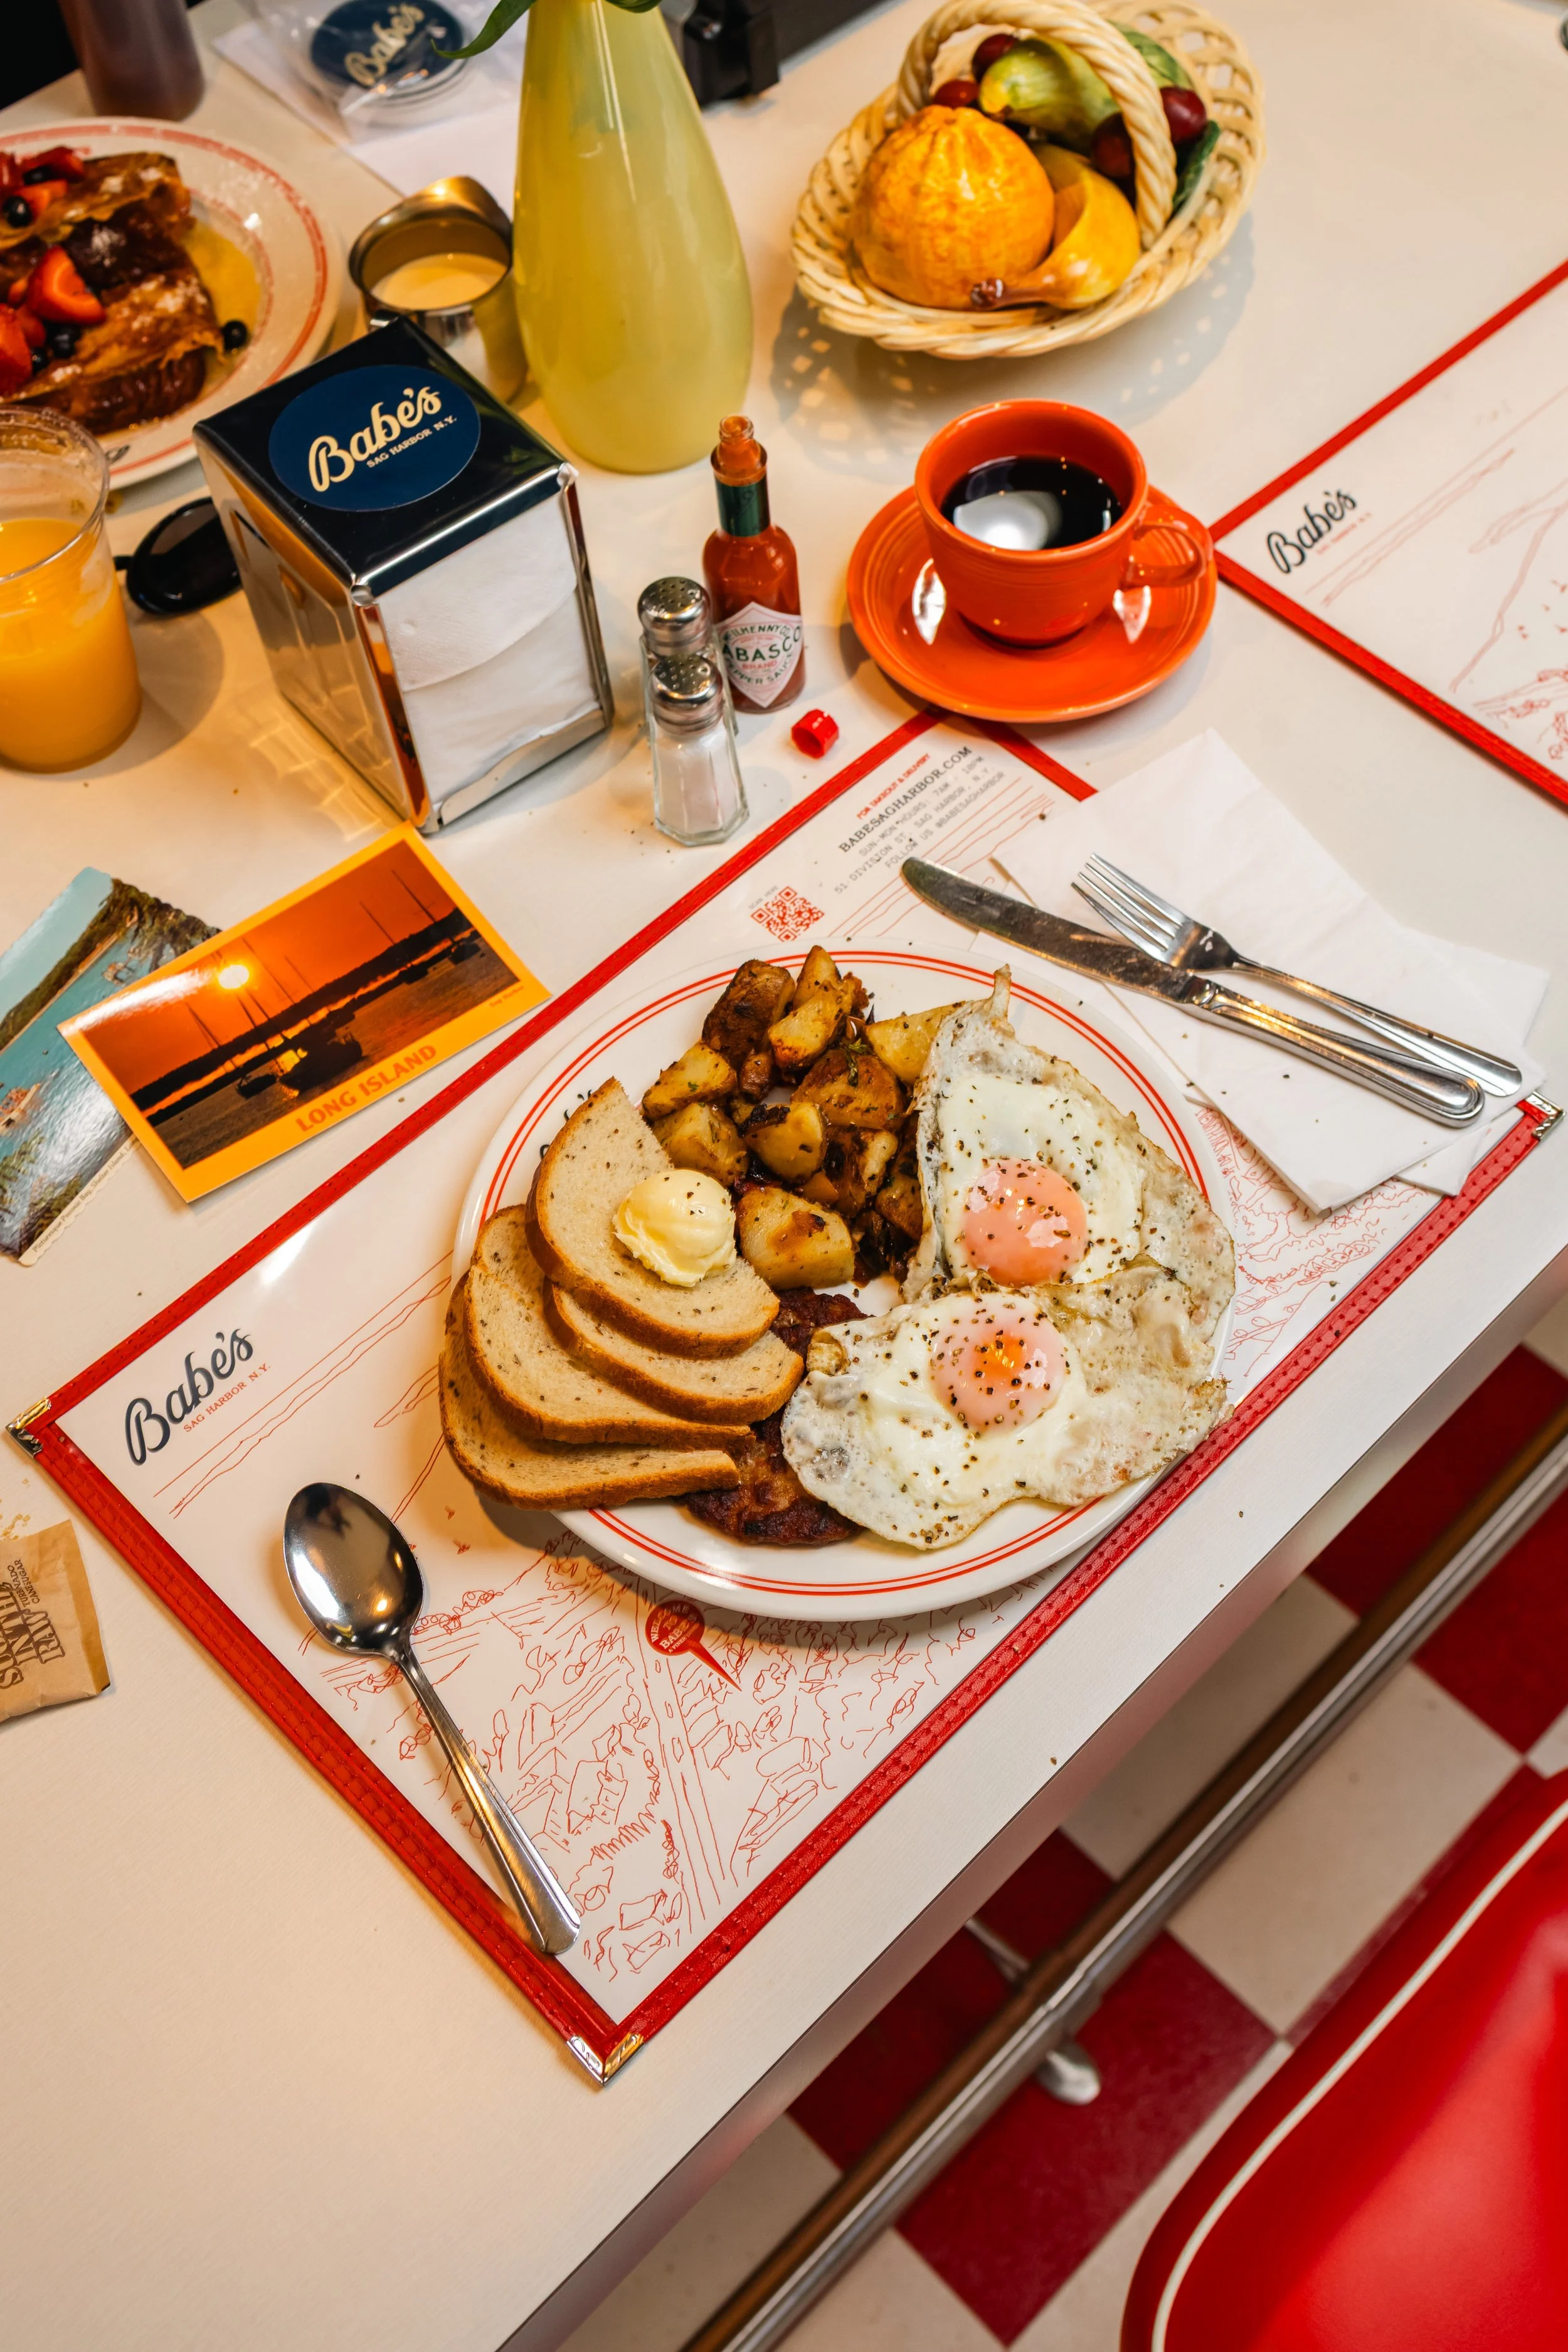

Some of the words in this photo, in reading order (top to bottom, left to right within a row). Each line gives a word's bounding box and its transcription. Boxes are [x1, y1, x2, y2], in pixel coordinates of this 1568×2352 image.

[309, 386, 442, 492] Babe's
[366, 452, 389, 468] SAG
[389, 428, 433, 455] HARBOR
[433, 415, 457, 431] N.Y.
[1266, 488, 1357, 575] Babe's
[723, 625, 801, 662] ABASCO
[838, 746, 972, 853] BABESAGHARBOR.COM
[857, 807, 871, 819] FOR
[849, 845, 893, 881] DIVISION
[914, 813, 933, 828] SAG
[885, 841, 918, 868] FOLLOW
[919, 828, 934, 841] US
[295, 1091, 357, 1132] LONG
[358, 1045, 437, 1096] ISLAND
[32, 1221, 62, 1253] Picturesque
[61, 1201, 82, 1222] Peconic
[91, 1169, 110, 1190] Shelter
[125, 1328, 253, 1466] Babe's
[183, 1414, 205, 1433] SAG
[205, 1381, 247, 1415] HARBOR
[247, 1362, 272, 1382] N.Y.
[25, 1610, 65, 1664] RAW
[650, 1603, 690, 1643] WELCOME
[663, 1615, 677, 1630] TO
[672, 1636, 687, 1650] FINER
